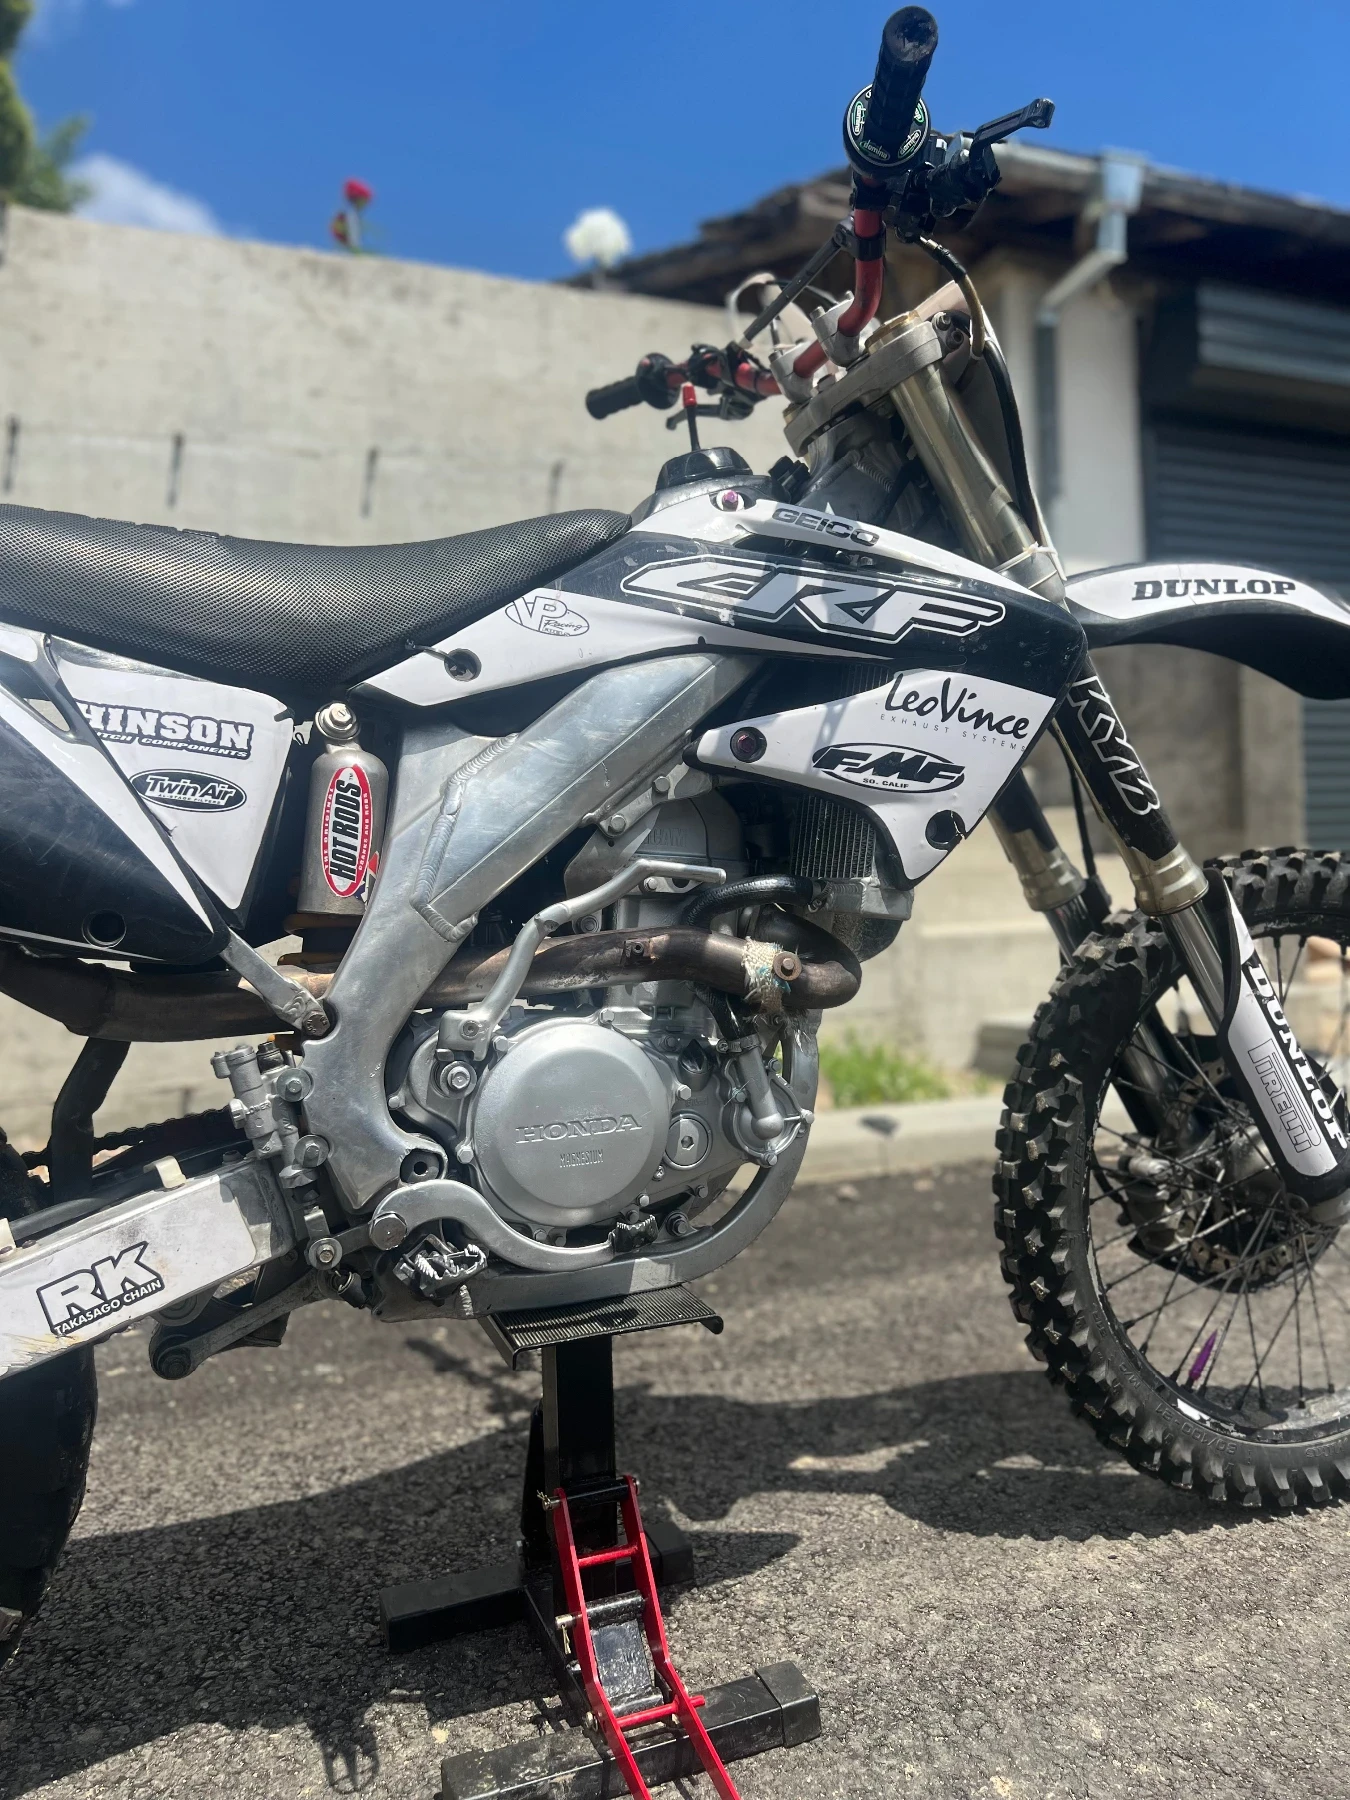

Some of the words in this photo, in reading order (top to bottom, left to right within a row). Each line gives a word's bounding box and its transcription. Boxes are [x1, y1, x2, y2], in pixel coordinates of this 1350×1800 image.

[772, 508, 879, 547] GEICO
[620, 554, 1005, 644] CRF
[1132, 579, 1296, 600] DUNLOP
[512, 595, 567, 632] VP
[77, 701, 253, 750] HINSON
[885, 672, 1030, 739] LeoVince
[141, 737, 248, 758] COMPONENTS
[880, 713, 950, 734] EXHAUST
[962, 731, 1026, 752] SYSTEMS
[813, 748, 966, 784] FMF
[863, 777, 878, 785] SO.
[882, 780, 909, 789] CALIF
[332, 779, 362, 841] RODS
[329, 836, 358, 882] HOT
[1248, 963, 1348, 1149] DUNLOP
[1247, 1038, 1322, 1153] PIRELLI
[515, 1114, 643, 1144] HONDA
[559, 1148, 604, 1168] MAGNESIUM
[36, 1240, 162, 1330] RK
[54, 1299, 121, 1336] TAKASAGO
[123, 1280, 161, 1303] CHAIN
